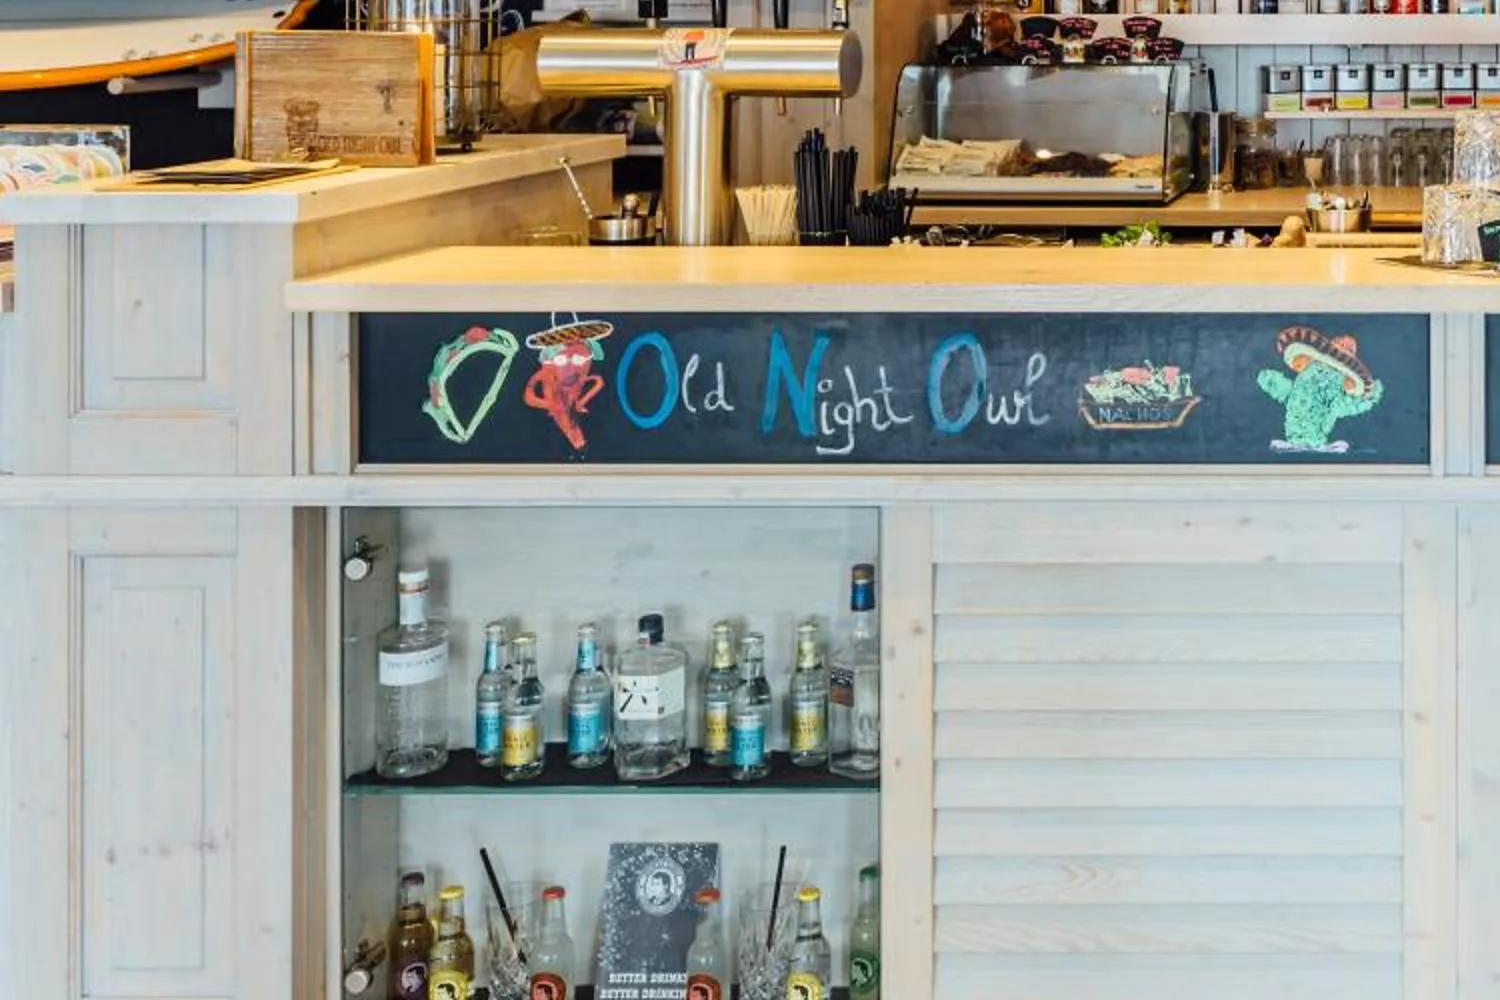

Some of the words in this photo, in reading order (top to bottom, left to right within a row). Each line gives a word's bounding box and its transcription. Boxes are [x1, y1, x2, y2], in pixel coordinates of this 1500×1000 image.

[616, 331, 734, 429] Old
[761, 328, 913, 455] Night
[927, 331, 1050, 435] Owl
[1099, 407, 1171, 422] NACHOS
